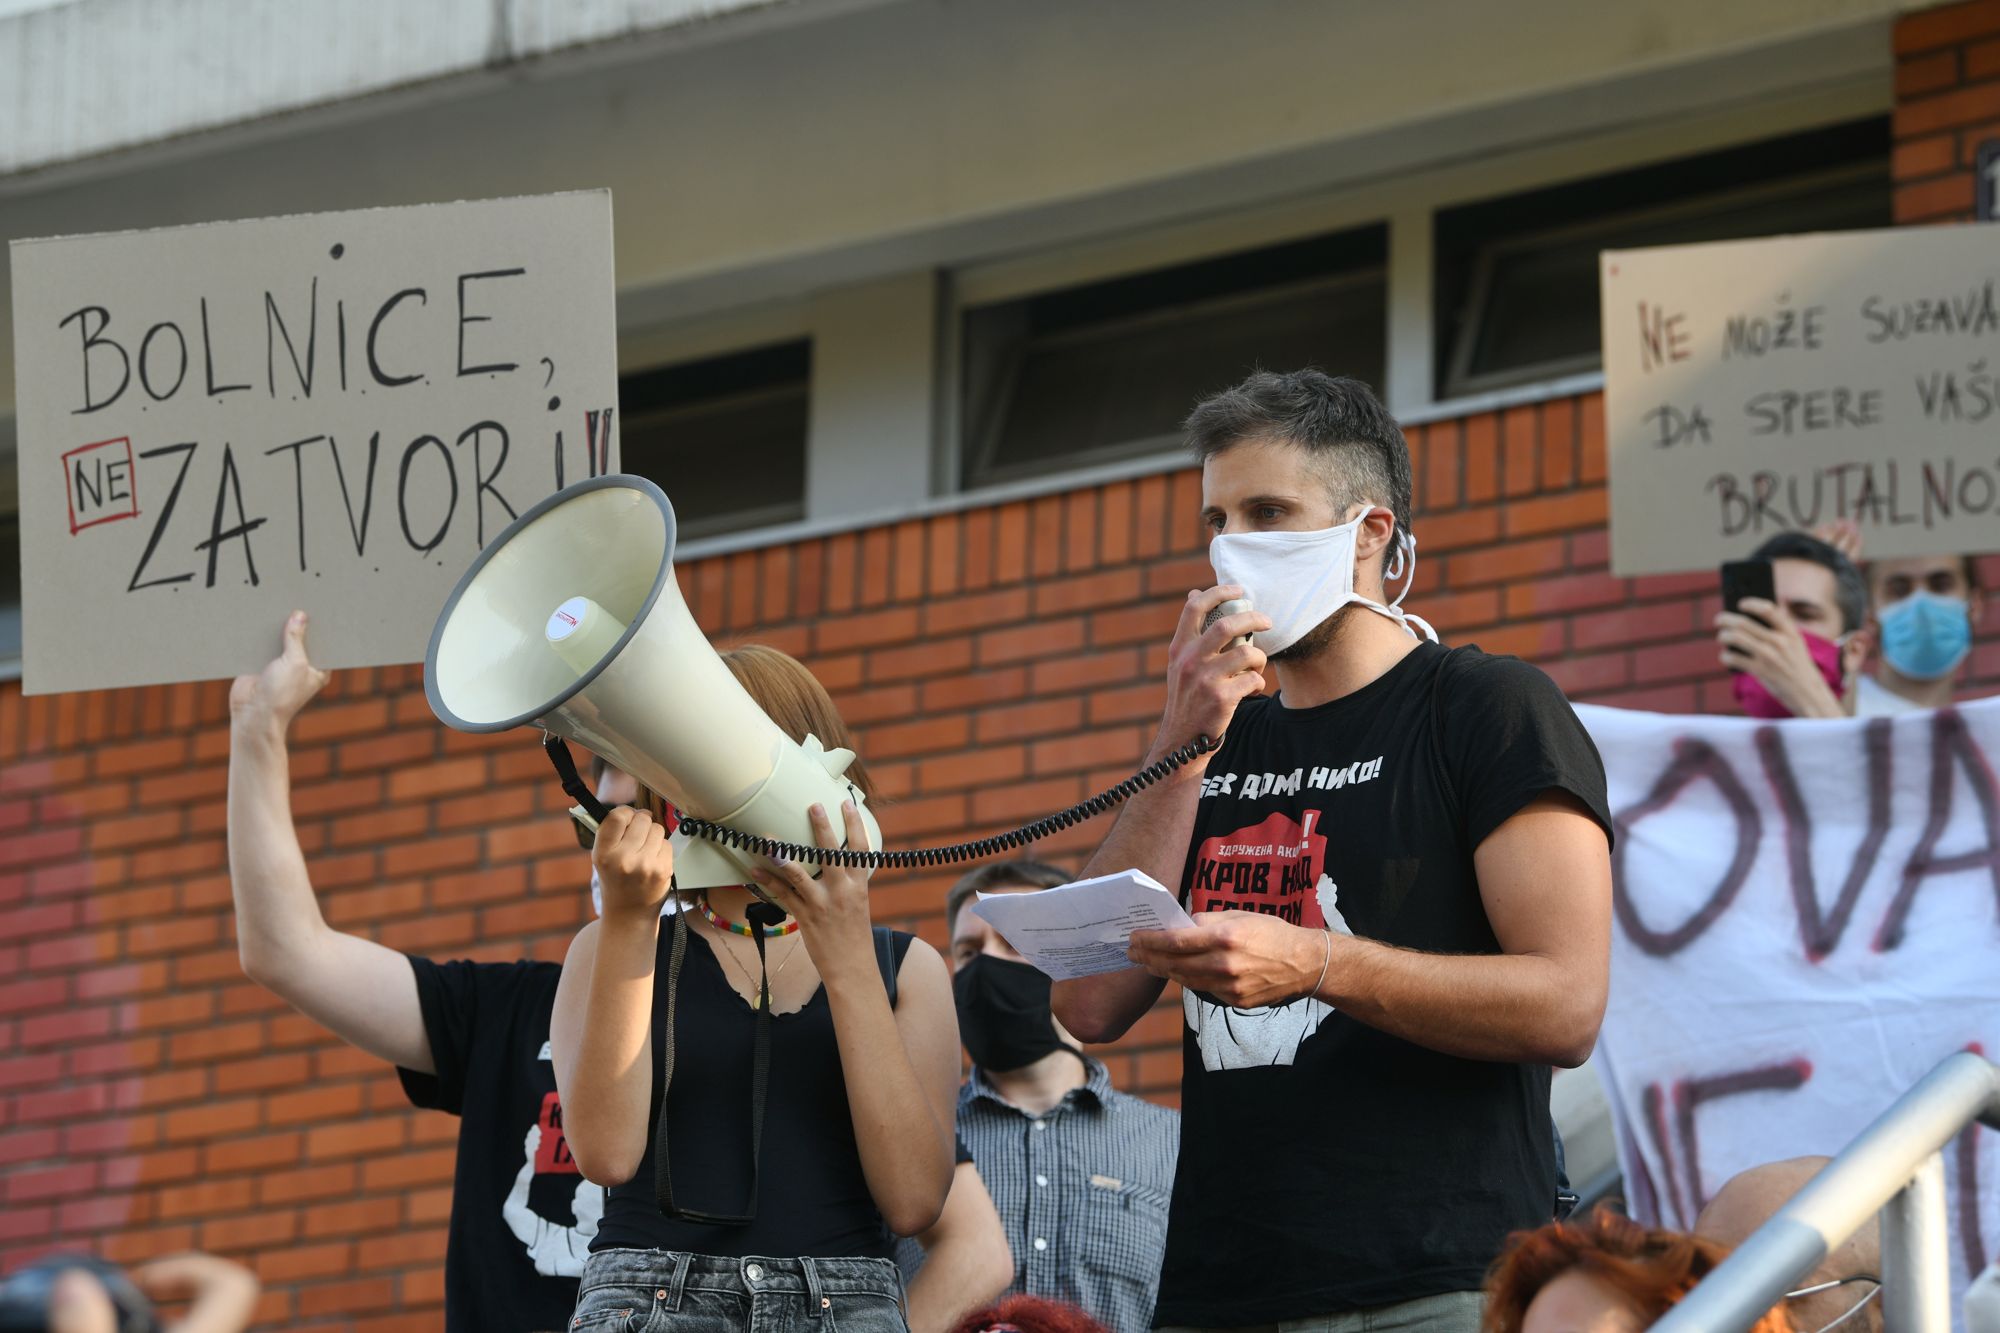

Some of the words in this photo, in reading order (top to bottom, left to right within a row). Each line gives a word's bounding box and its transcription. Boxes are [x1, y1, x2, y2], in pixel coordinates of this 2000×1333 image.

[1639, 300, 1692, 373] NE
[1719, 290, 1828, 361] MOŽE
[1642, 404, 1712, 449] DA
[1743, 386, 1883, 436] SPERE
[74, 456, 132, 513] NE
[1706, 456, 2000, 537] BRUTALNO
[1196, 858, 1271, 894] КРОВ
[1218, 844, 1273, 857] ЗДРУЖЕНА
